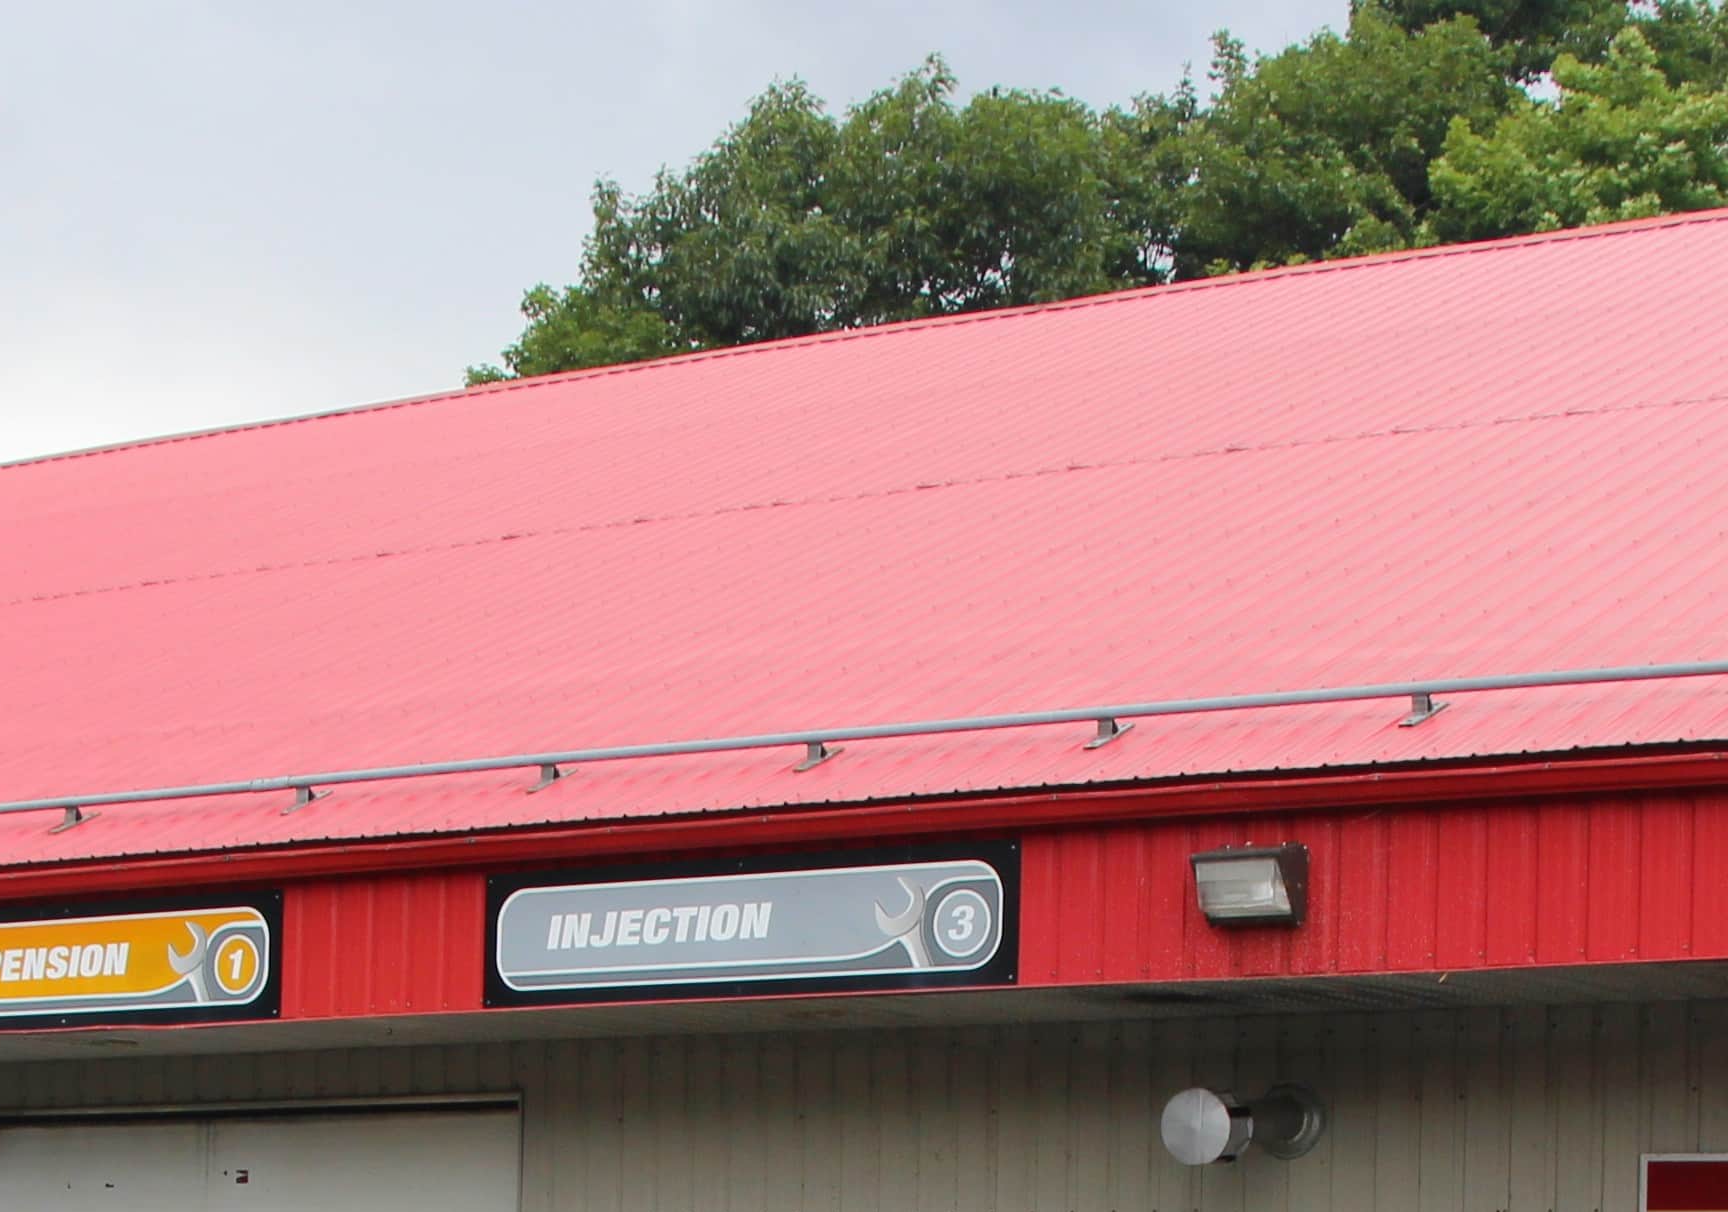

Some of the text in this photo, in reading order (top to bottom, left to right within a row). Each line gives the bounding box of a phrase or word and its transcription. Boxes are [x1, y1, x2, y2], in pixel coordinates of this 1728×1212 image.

[546, 901, 974, 951] INJECTION 3
[229, 948, 244, 980] 1
